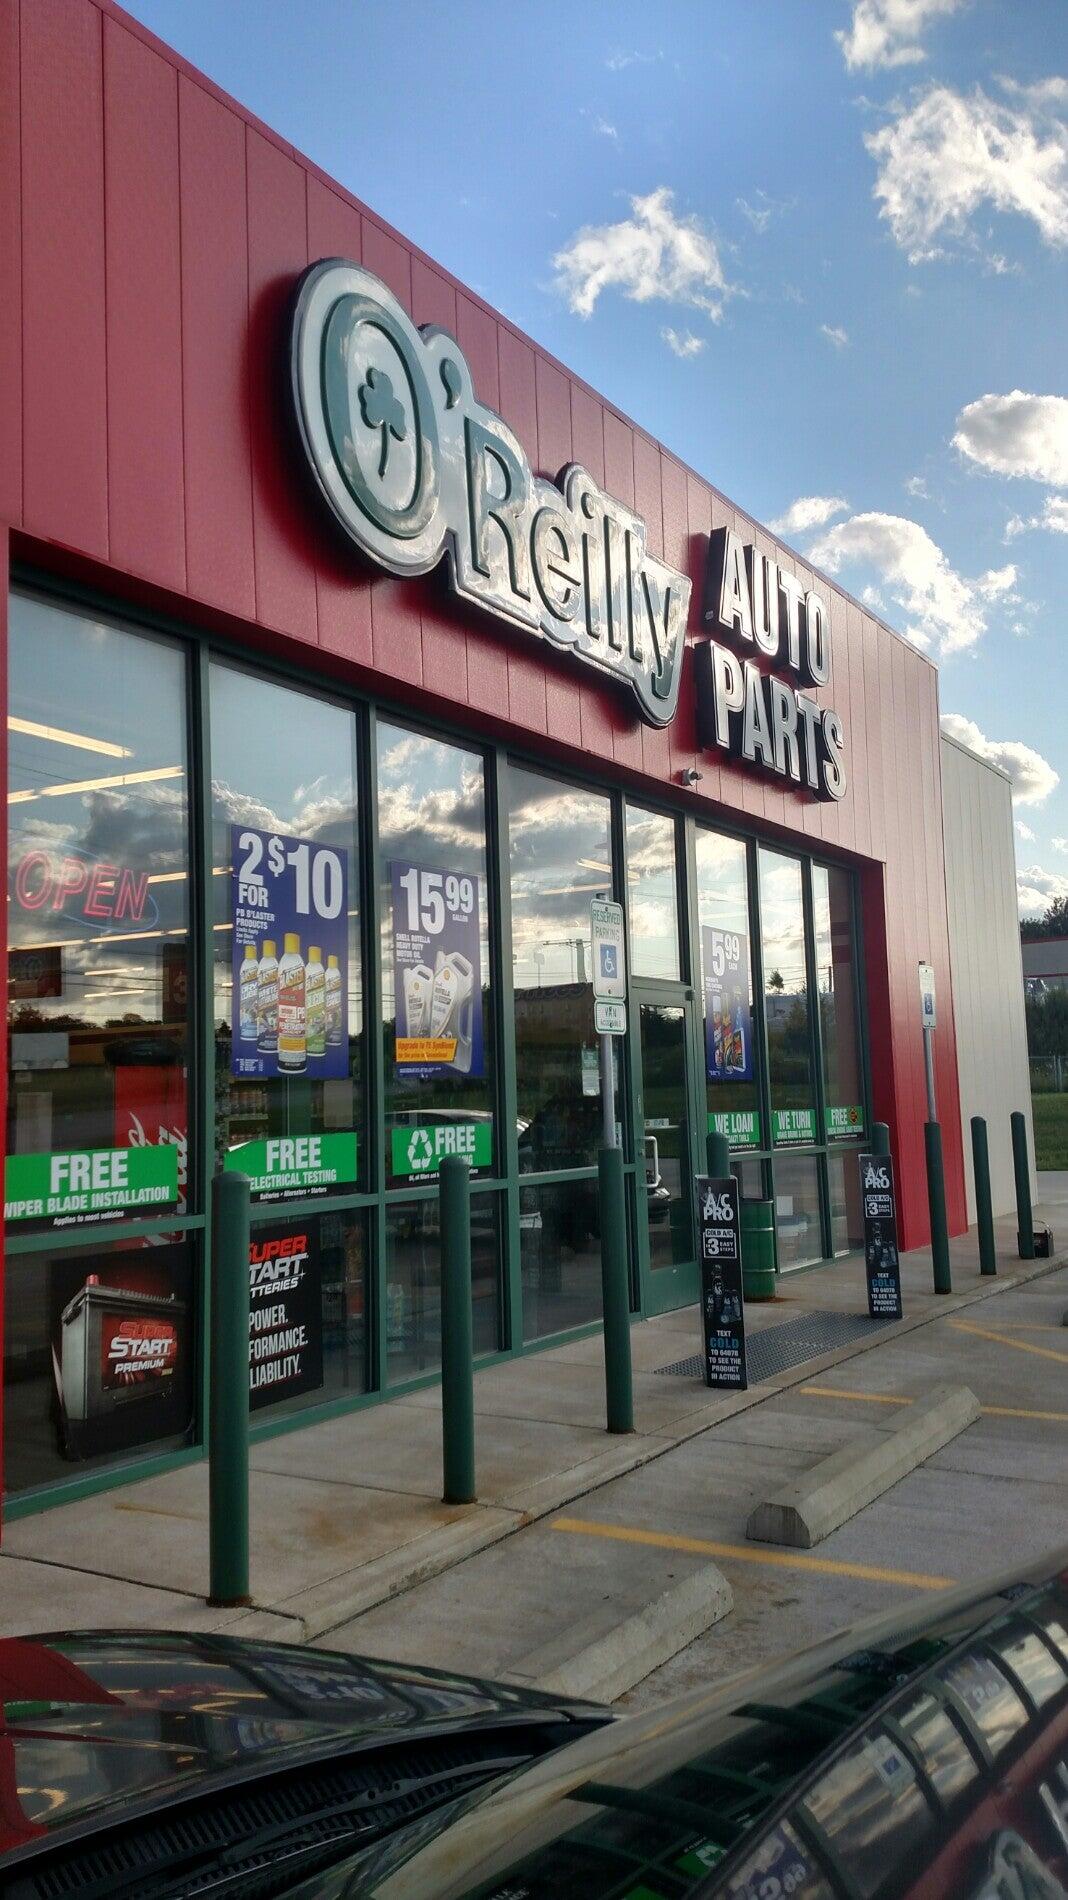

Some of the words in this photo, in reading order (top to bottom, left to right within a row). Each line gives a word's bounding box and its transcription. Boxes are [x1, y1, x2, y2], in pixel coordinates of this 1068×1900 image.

[318, 290, 683, 701] O'Reilly
[714, 527, 831, 689] AUTO
[706, 641, 847, 801] PARTS
[239, 832, 264, 886] 2
[15, 850, 150, 920] OPEN
[239, 884, 268, 908] FOR
[236, 908, 245, 917] PB
[593, 909, 620, 925] RESERVED
[236, 918, 268, 930] PRODUCTS
[595, 926, 620, 941] PARKING
[605, 1006, 617, 1018] VAN
[714, 1114, 730, 1134] WE
[731, 1113, 754, 1133] LOAN
[777, 1111, 791, 1130] WE
[792, 1110, 811, 1129] TURN
[831, 1108, 848, 1126] FREE
[435, 1125, 476, 1155] FREE
[267, 1137, 321, 1173] FREE
[51, 1151, 129, 1193] FREE
[249, 1173, 301, 1191] ELECTRICAL
[303, 1169, 337, 1184] TESTING
[866, 1166, 887, 1179] A/C
[865, 1177, 890, 1189] PRO
[47, 1194, 88, 1213] BLADE
[91, 1186, 170, 1209] INSTALLATION
[705, 1192, 731, 1208] A/C
[869, 1202, 878, 1215] 3
[53, 1215, 76, 1226] Applies
[77, 1214, 84, 1222] to
[85, 1213, 100, 1222] most
[101, 1210, 125, 1220] vehicles
[703, 1206, 734, 1221] PRO
[707, 1238, 720, 1255] 3
[249, 1252, 308, 1285] TART
[250, 1277, 299, 1299] TTERIES
[871, 1279, 896, 1287] COLD
[107, 1336, 174, 1359] START
[248, 1325, 309, 1362] FORMANCE.
[710, 1338, 740, 1349] COLD
[114, 1358, 165, 1375] PREMIUM
[711, 1365, 740, 1373] PRODUCT
[730, 1357, 742, 1365] THE
[250, 1353, 301, 1390] LIABILITY.
